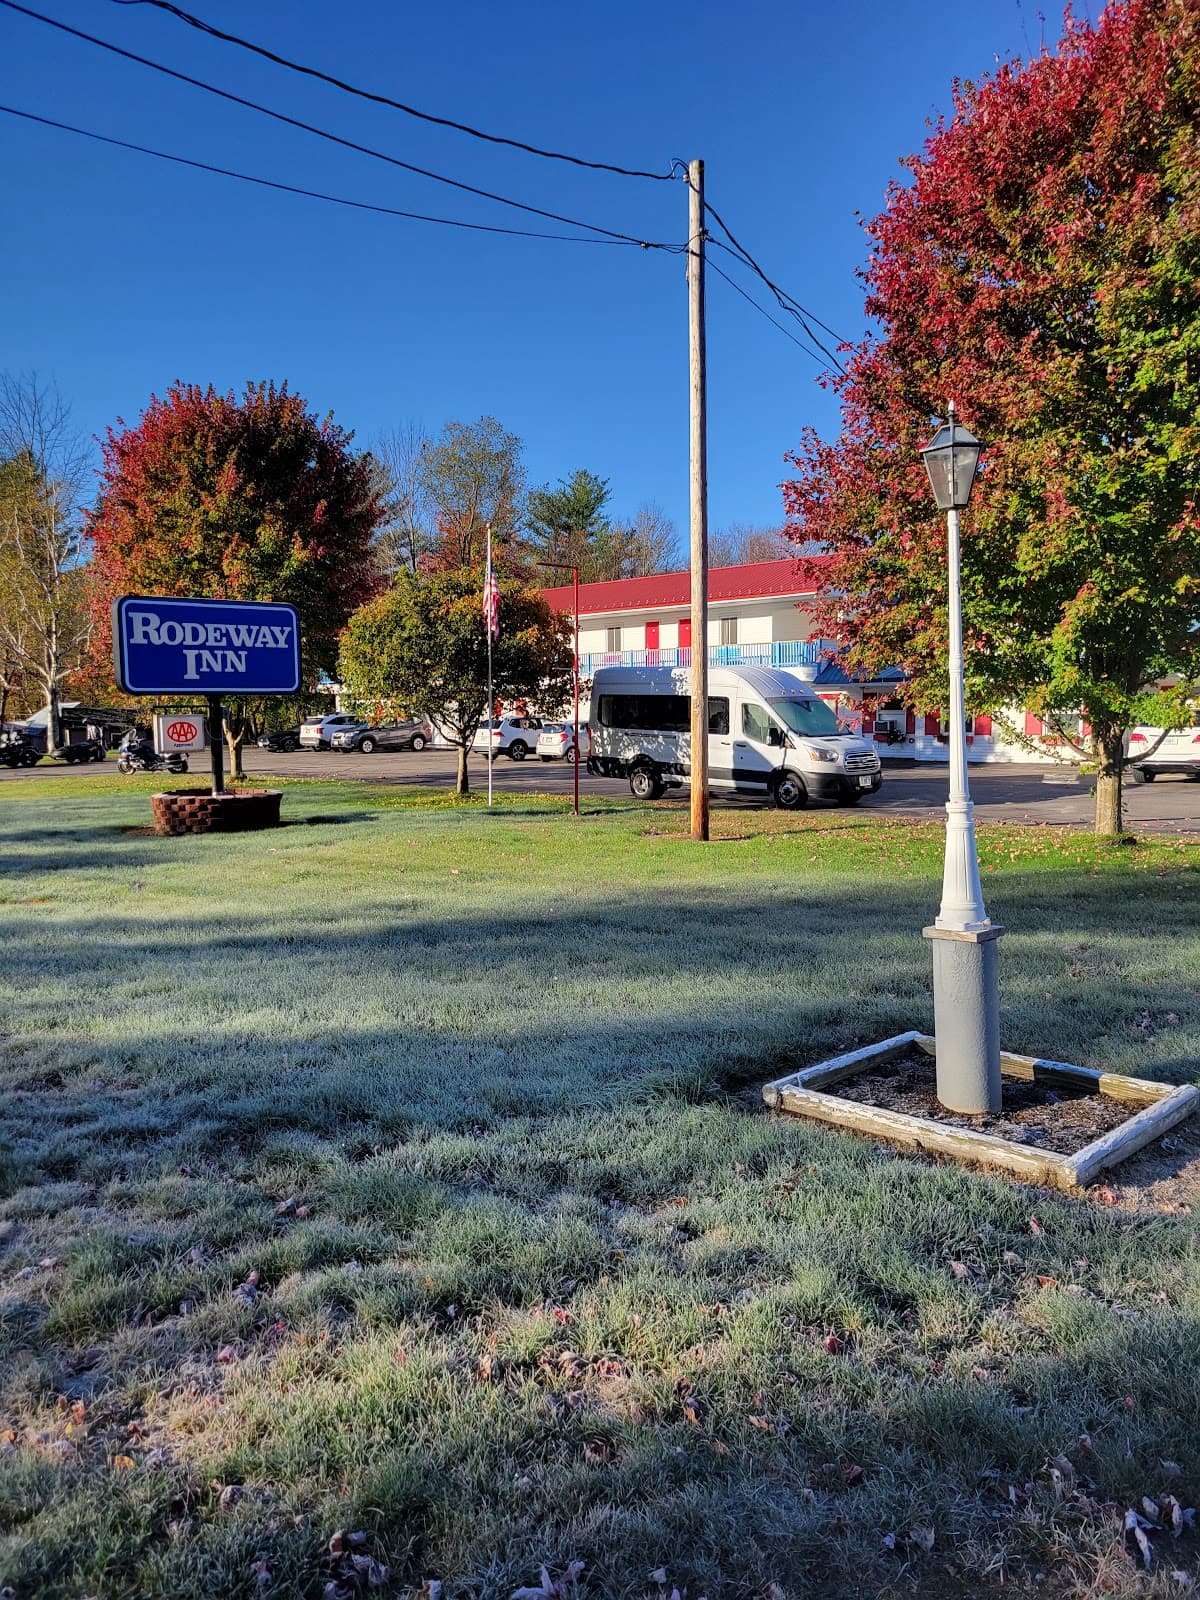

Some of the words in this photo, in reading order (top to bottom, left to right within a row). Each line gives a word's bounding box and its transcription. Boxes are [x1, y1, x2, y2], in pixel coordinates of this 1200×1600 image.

[128, 612, 292, 648] RODEWAY
[183, 650, 248, 680] INN
[170, 721, 195, 742] AAA
